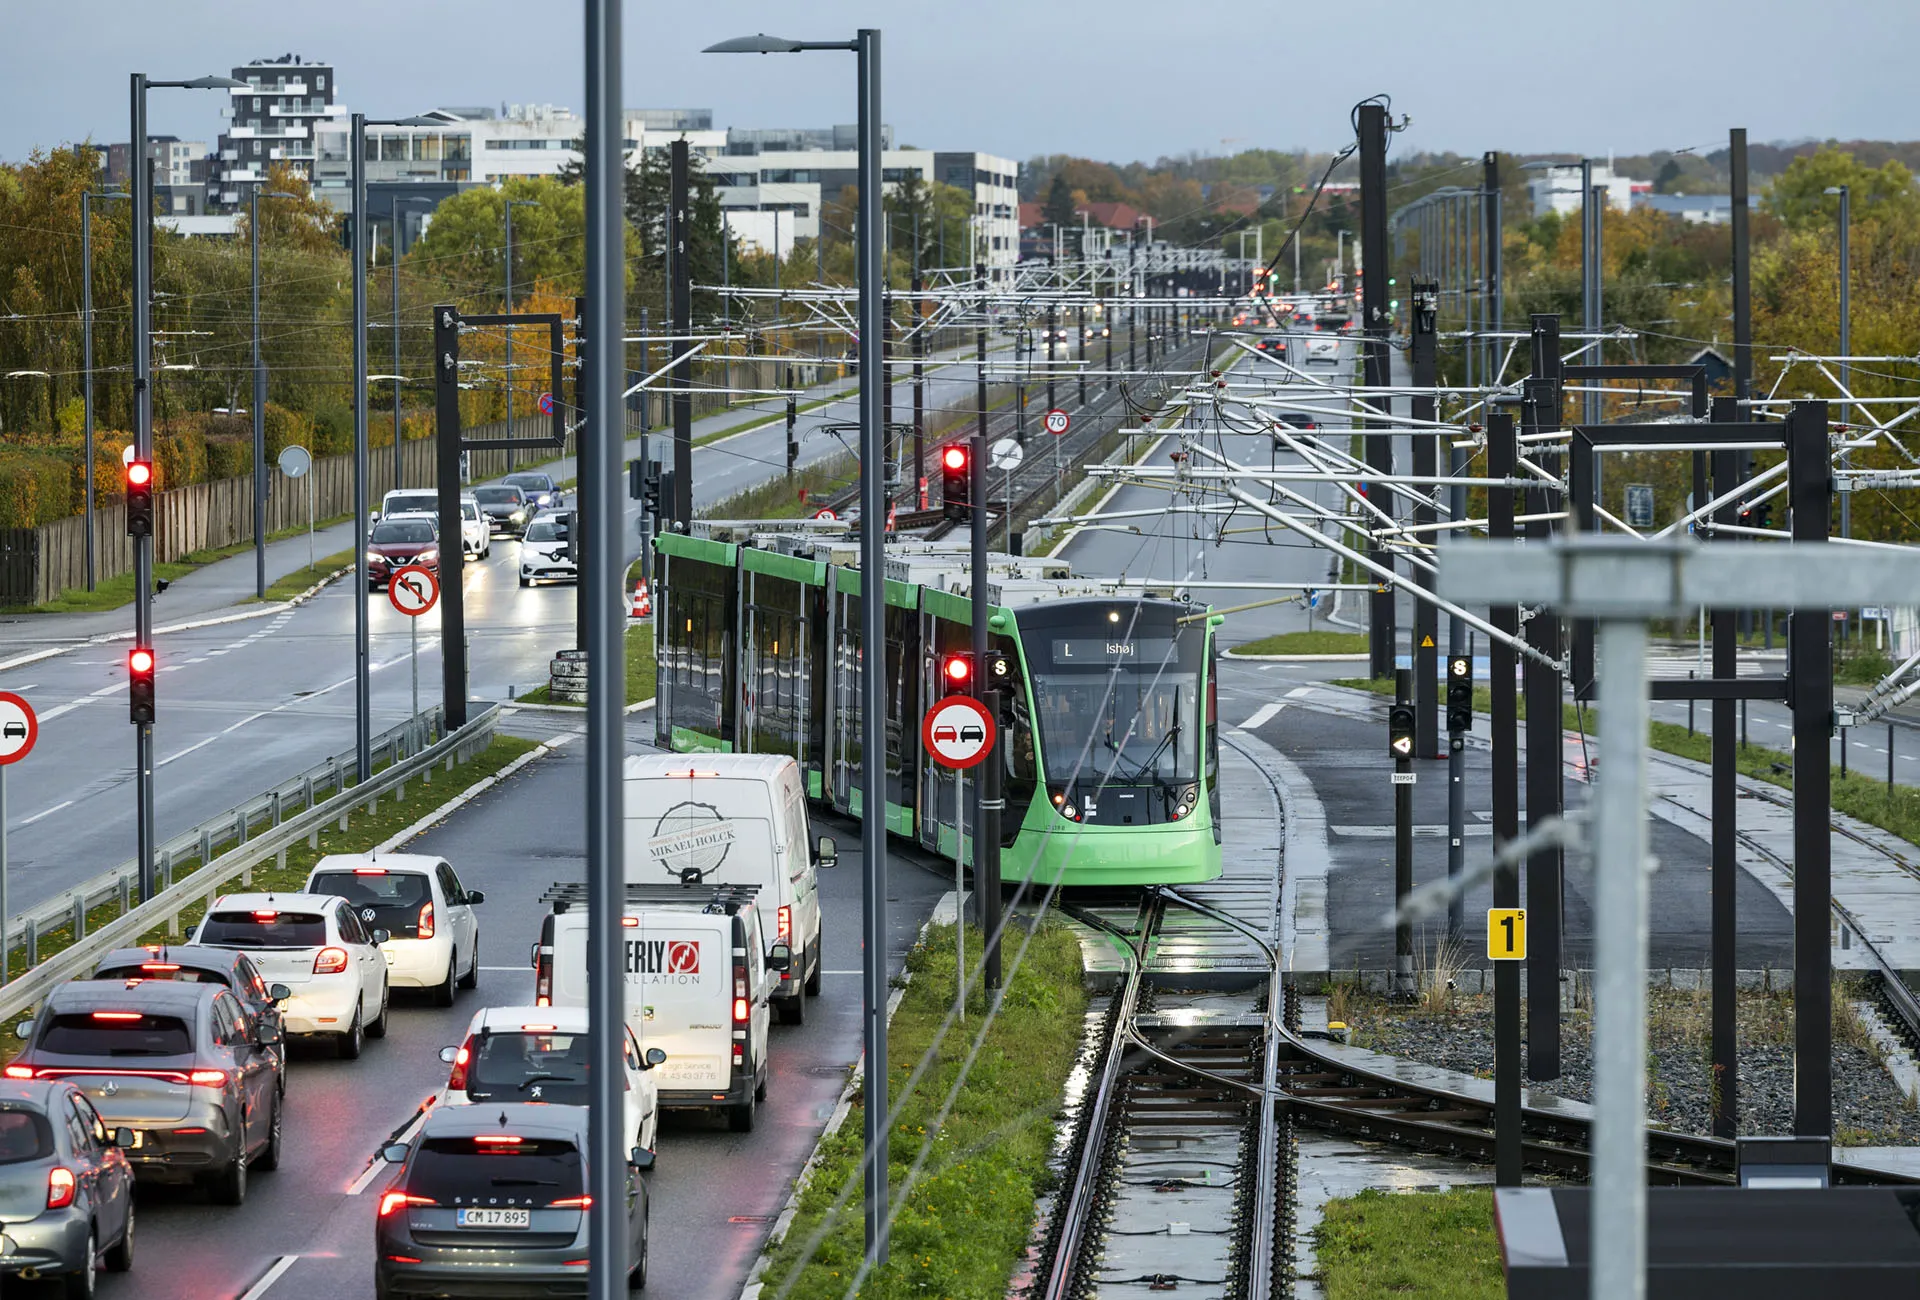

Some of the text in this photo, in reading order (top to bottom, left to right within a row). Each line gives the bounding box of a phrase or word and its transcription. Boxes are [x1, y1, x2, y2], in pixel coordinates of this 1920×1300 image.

[1050, 416, 1065, 427] 70
[1064, 642, 1134, 657] L Ishøj
[995, 660, 1007, 675] S
[1453, 660, 1467, 676] S
[649, 829, 736, 858] MIKAEL HOLCK
[1500, 911, 1525, 952] 1 5
[466, 1211, 527, 1224] CM 17 895
